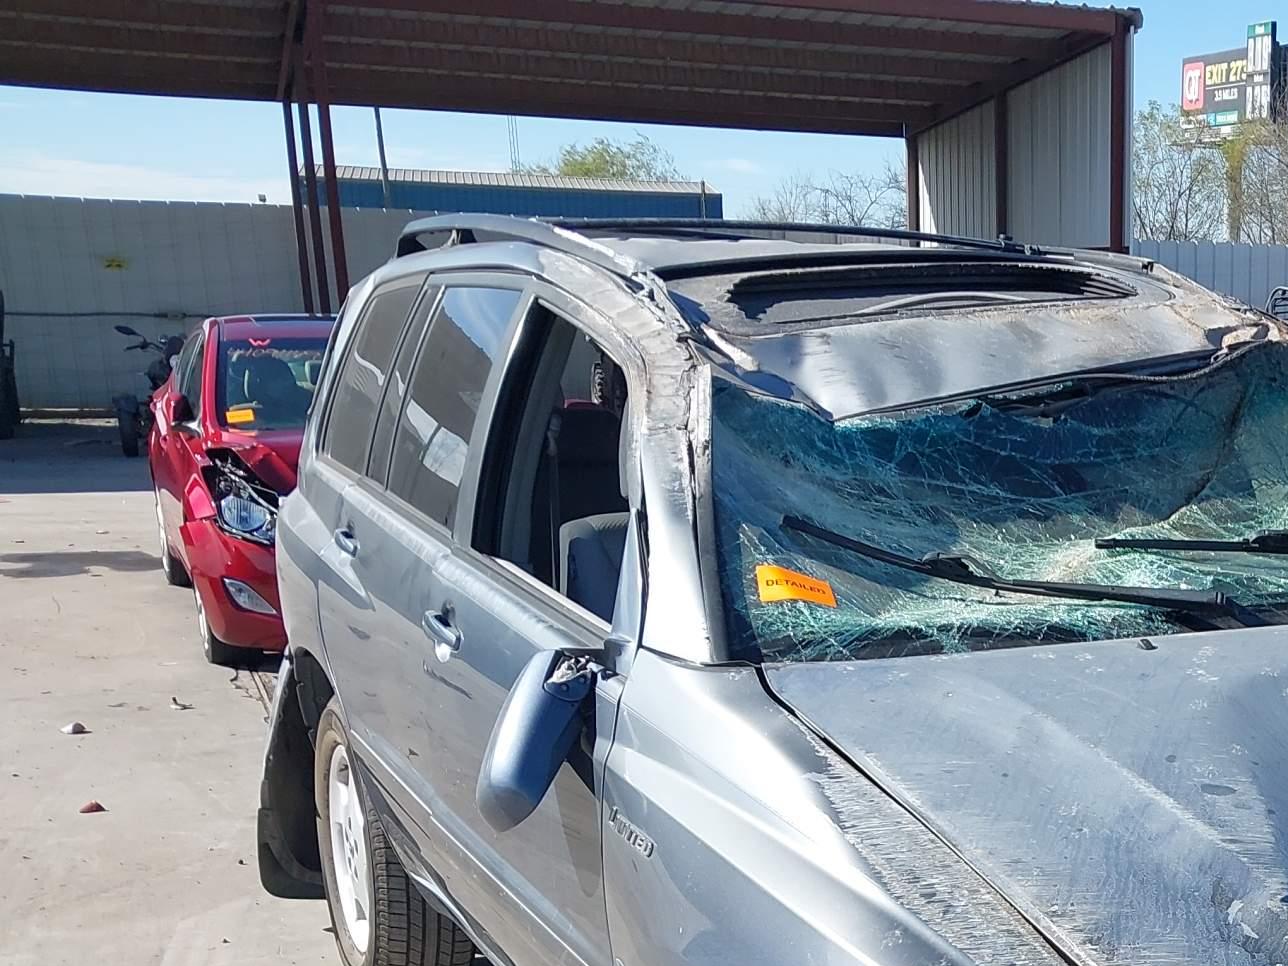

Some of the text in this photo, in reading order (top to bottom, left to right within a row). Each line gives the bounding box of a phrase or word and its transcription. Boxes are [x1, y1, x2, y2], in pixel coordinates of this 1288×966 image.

[1205, 62, 1228, 85] EXIT
[1185, 69, 1201, 105] QT
[764, 578, 827, 596] DETAILED
